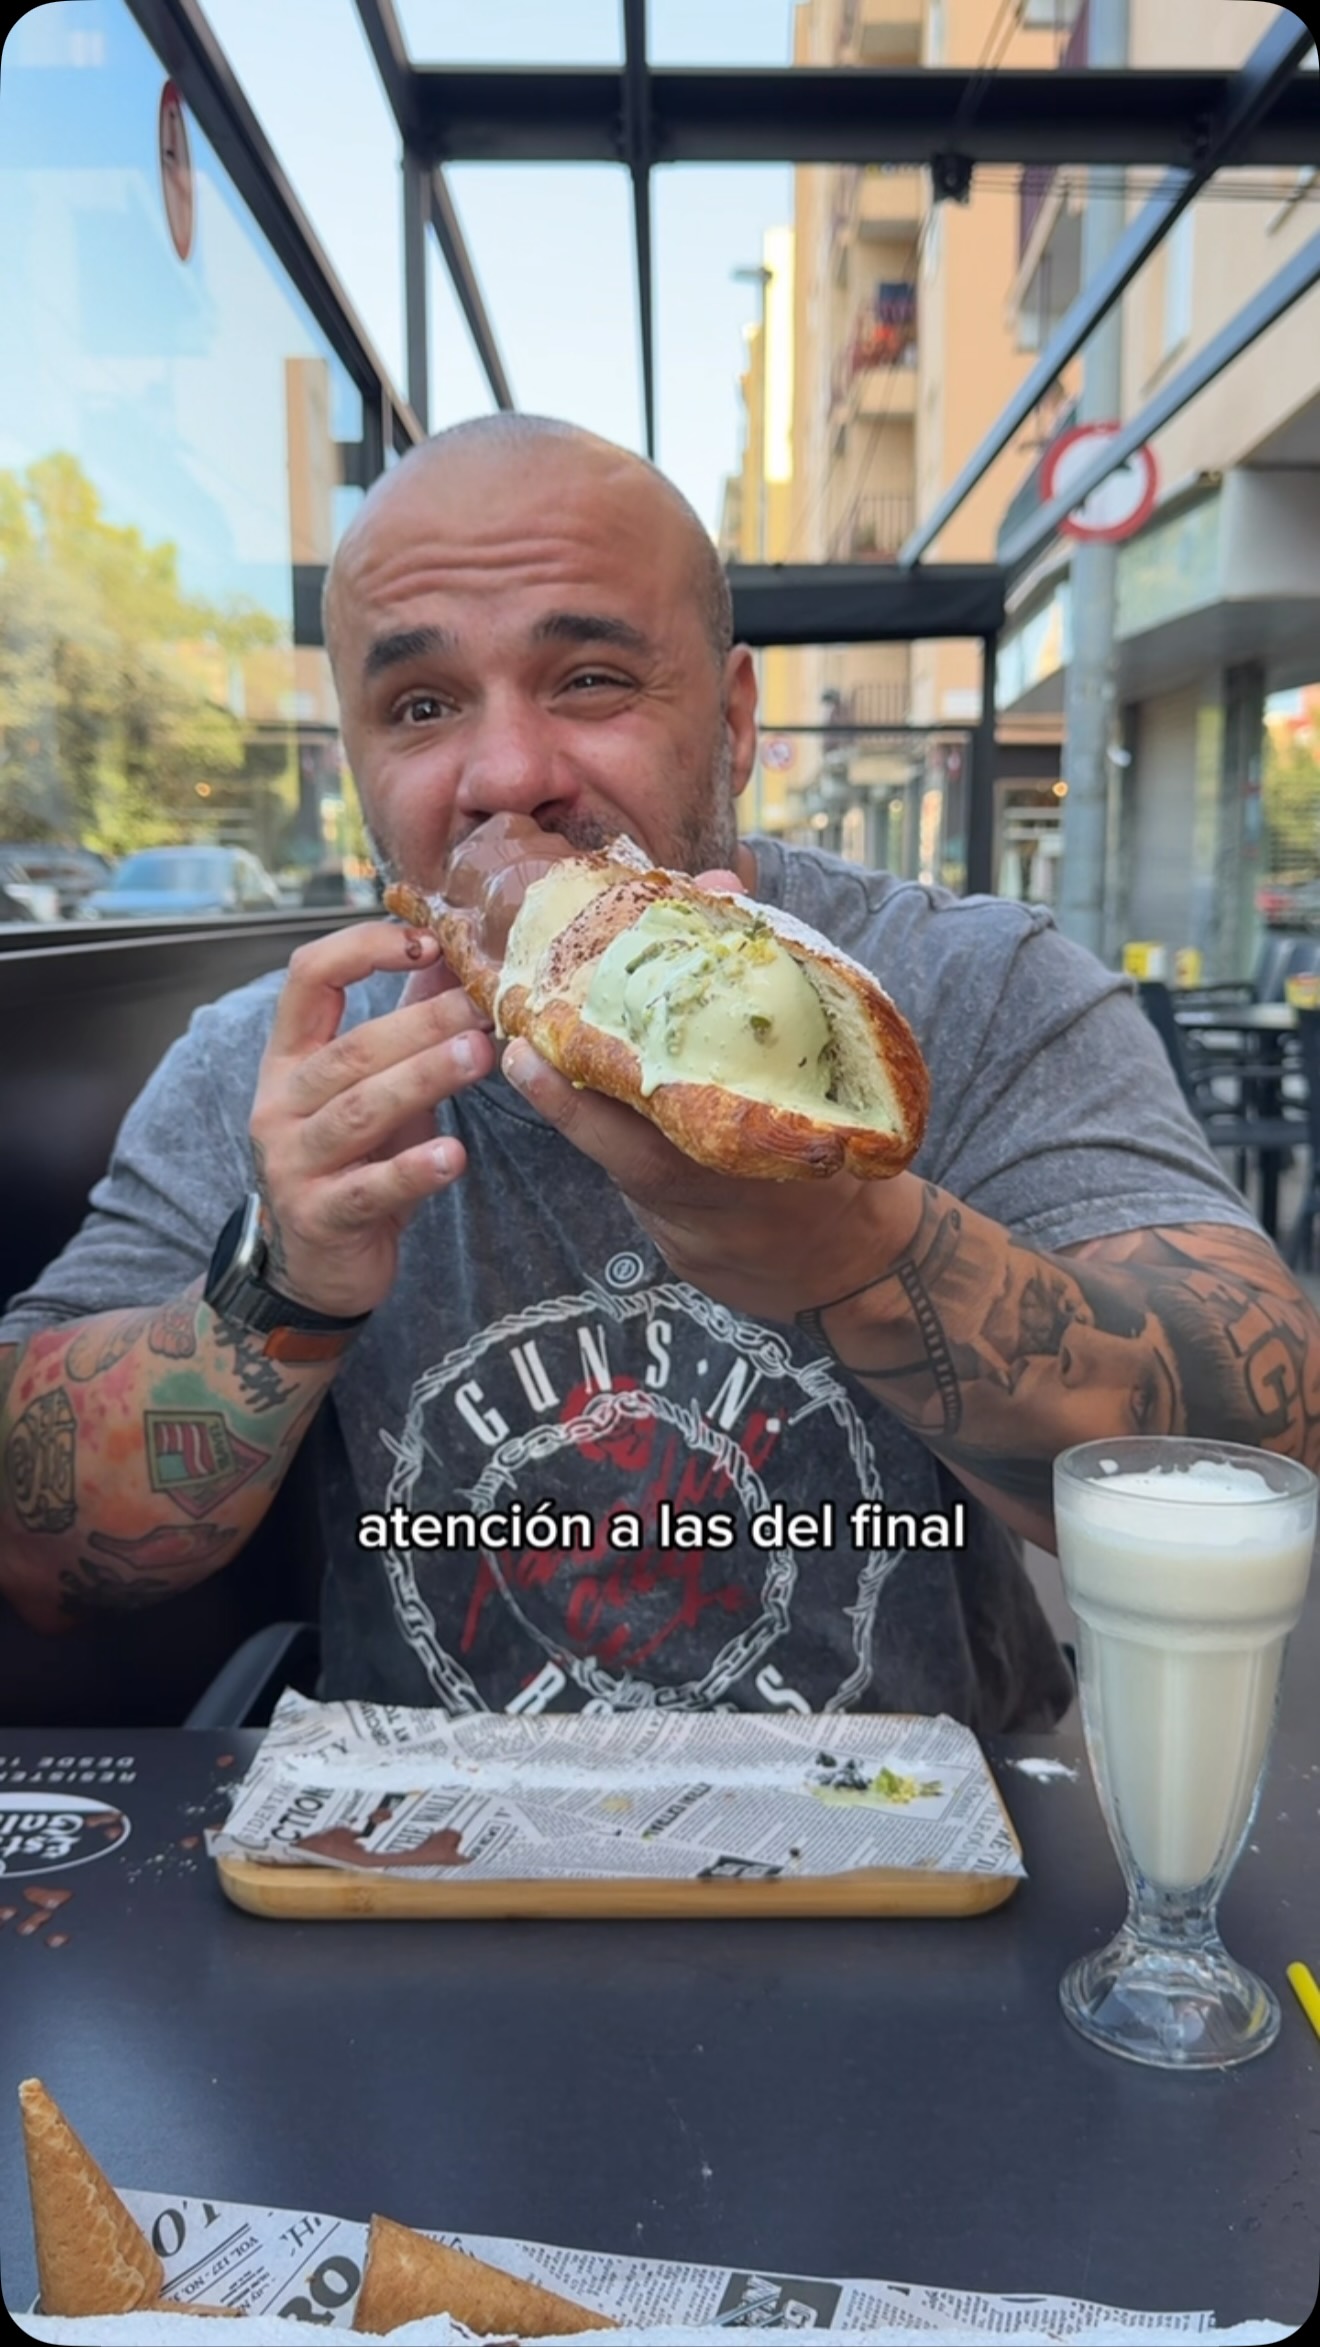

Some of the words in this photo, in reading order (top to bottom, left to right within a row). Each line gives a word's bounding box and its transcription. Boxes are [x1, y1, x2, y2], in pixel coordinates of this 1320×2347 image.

[38, 1756, 135, 1768] DESDE
[231, 2235, 260, 2260] VOL.
[211, 2255, 231, 2278] 127
[181, 2279, 206, 2297] NO.
